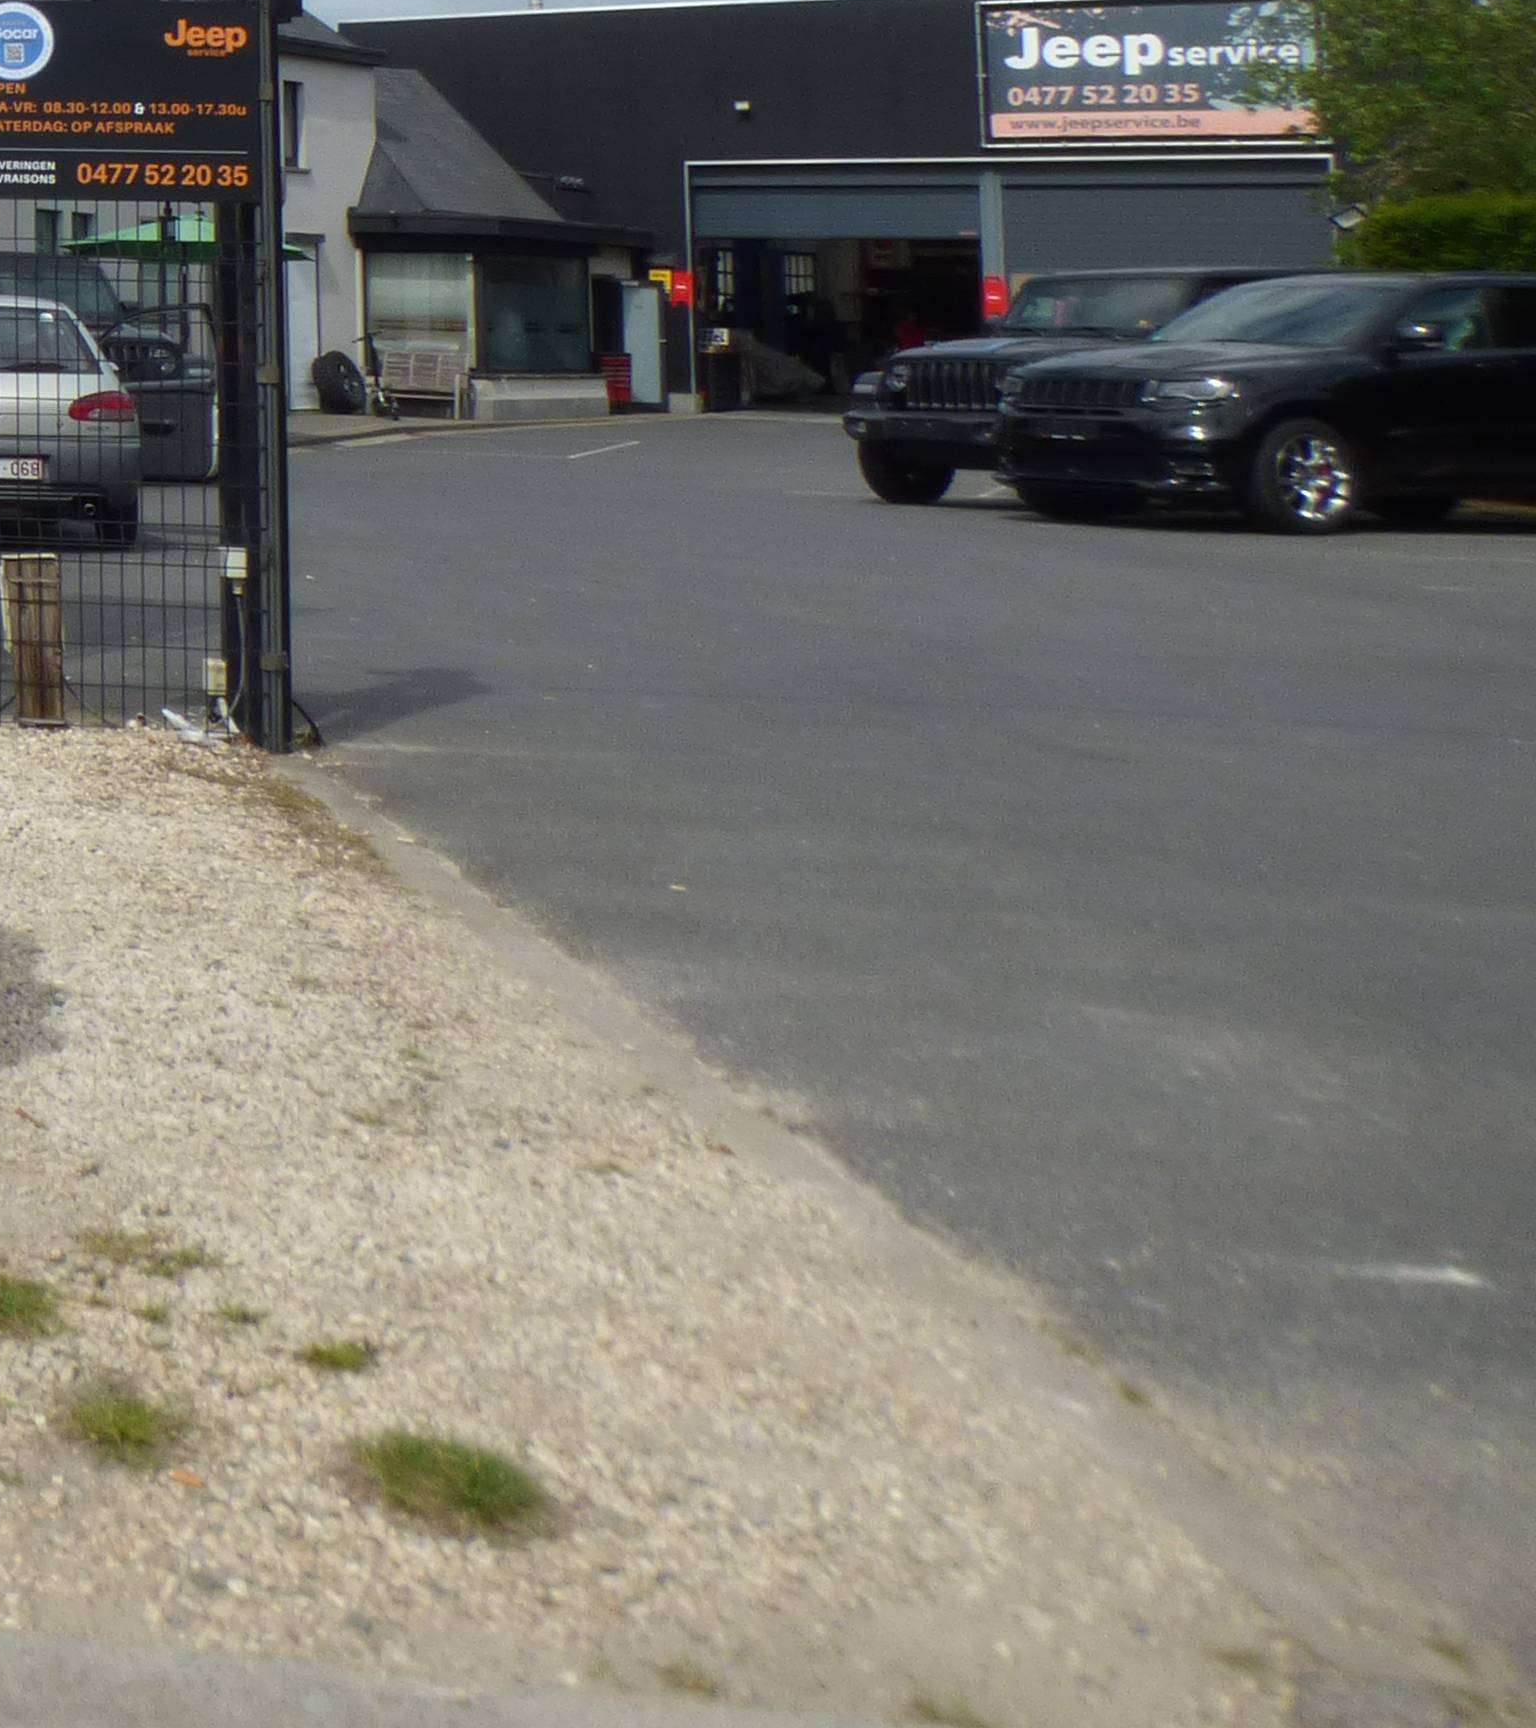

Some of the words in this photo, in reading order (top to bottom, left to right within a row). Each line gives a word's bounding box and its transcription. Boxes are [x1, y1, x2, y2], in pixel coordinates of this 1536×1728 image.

[163, 18, 248, 54] Jeep
[1003, 26, 1165, 76] Jeep
[1167, 38, 1300, 67] service
[1006, 84, 1075, 107] 0477
[1081, 84, 1117, 105] 52
[1122, 83, 1159, 104] 20
[1163, 82, 1201, 103] 35
[134, 101, 145, 115] &
[71, 120, 93, 133] OP
[95, 121, 176, 134] AFSPRAAK
[1009, 114, 1202, 134] www.jeepservice.be
[76, 162, 140, 185] 0477
[144, 164, 177, 186] 52
[180, 164, 213, 187] 20
[216, 164, 249, 187] 35
